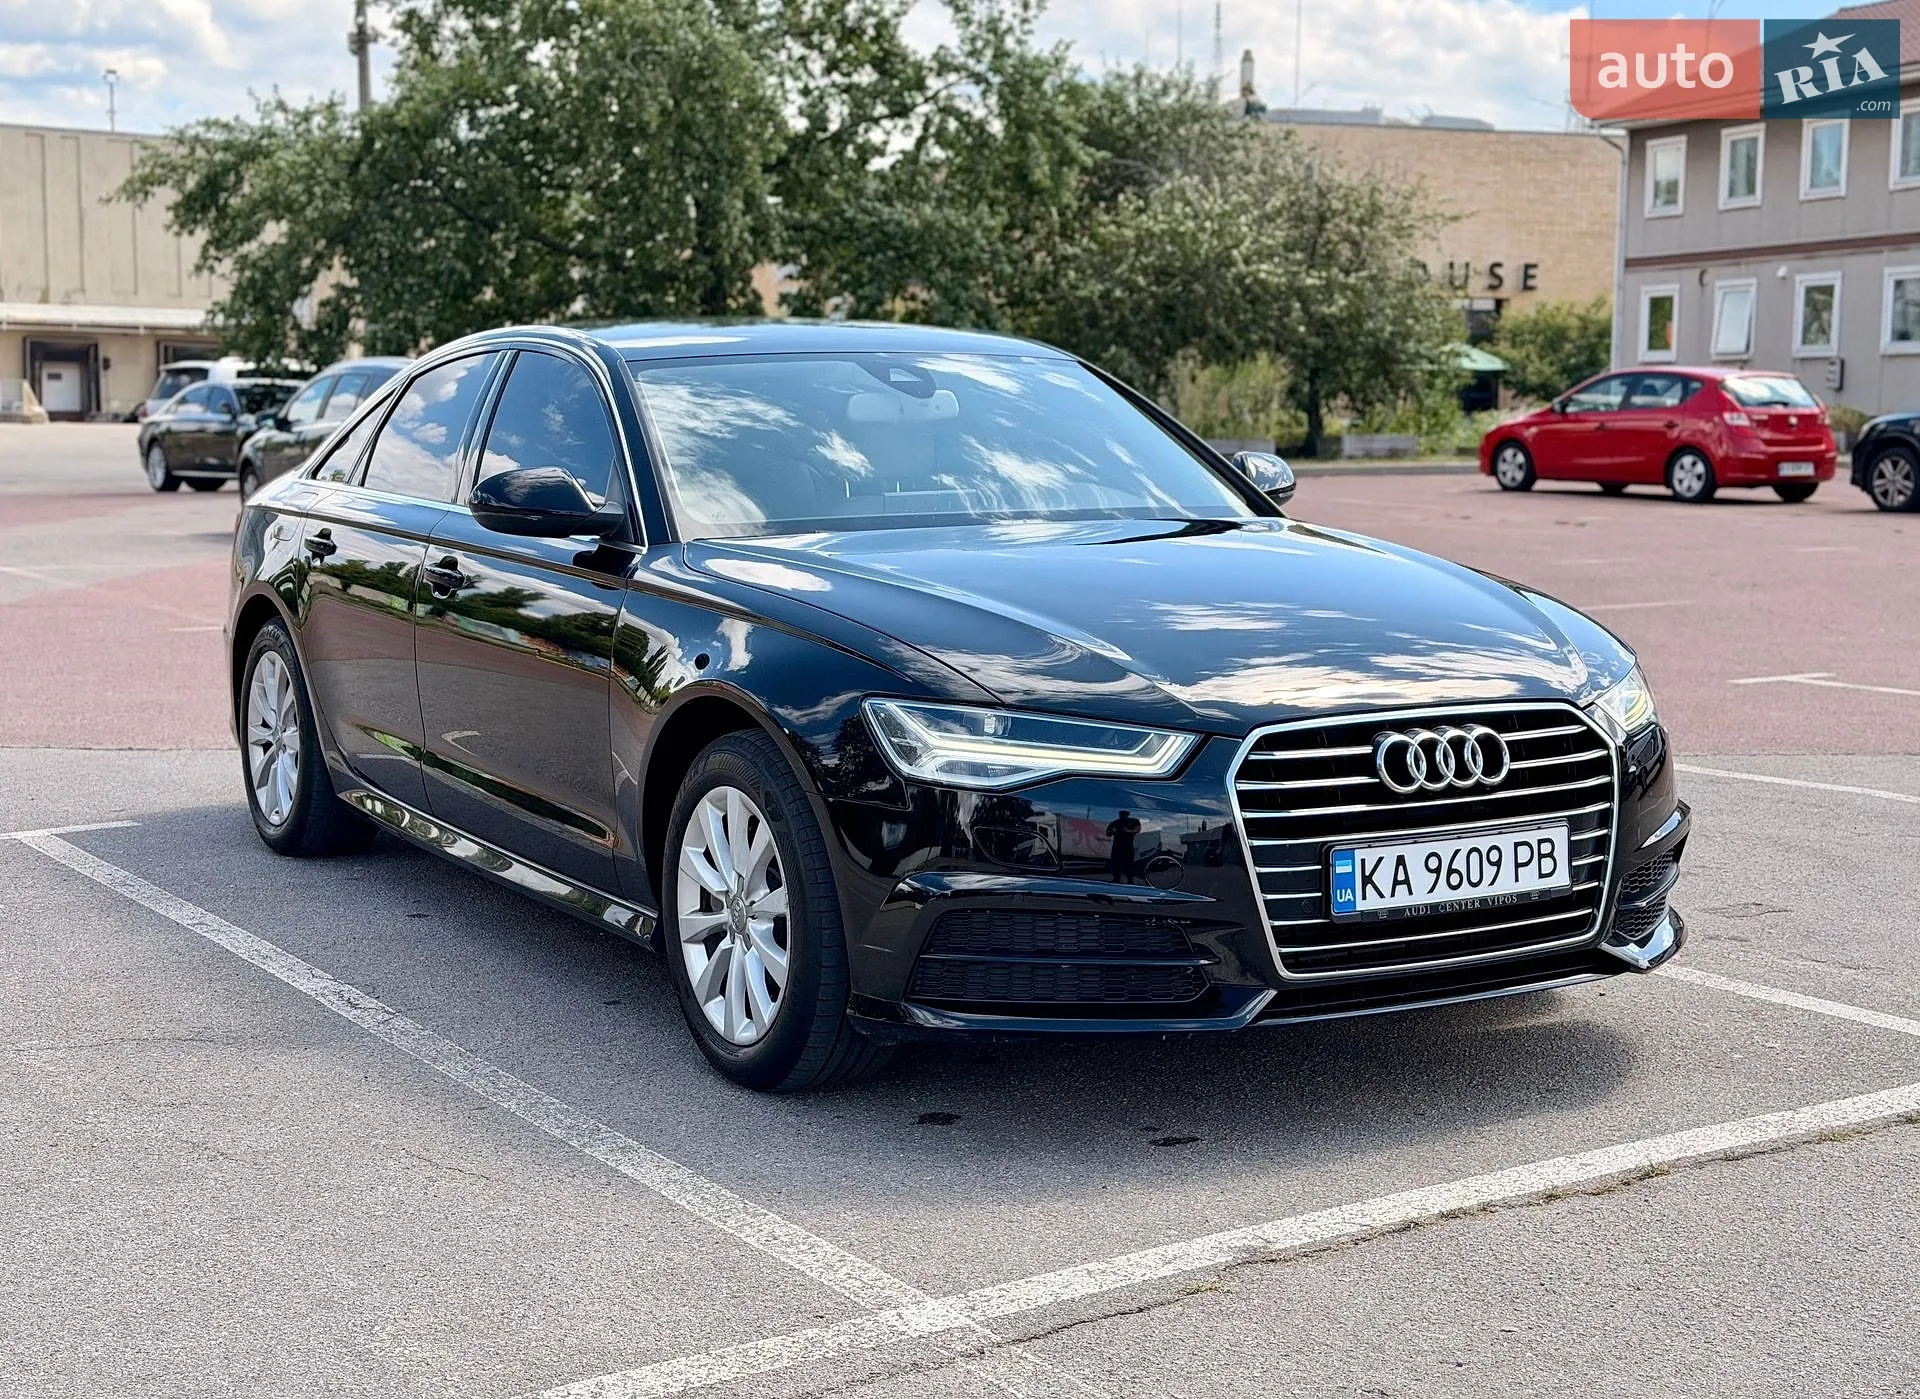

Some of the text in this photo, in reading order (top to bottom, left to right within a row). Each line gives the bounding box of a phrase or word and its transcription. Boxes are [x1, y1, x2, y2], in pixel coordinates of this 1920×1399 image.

[1360, 838, 1557, 901] KA 9609 PB
[1336, 888, 1354, 902] UA
[1404, 893, 1518, 916] AUDI CENTER VIPOS
